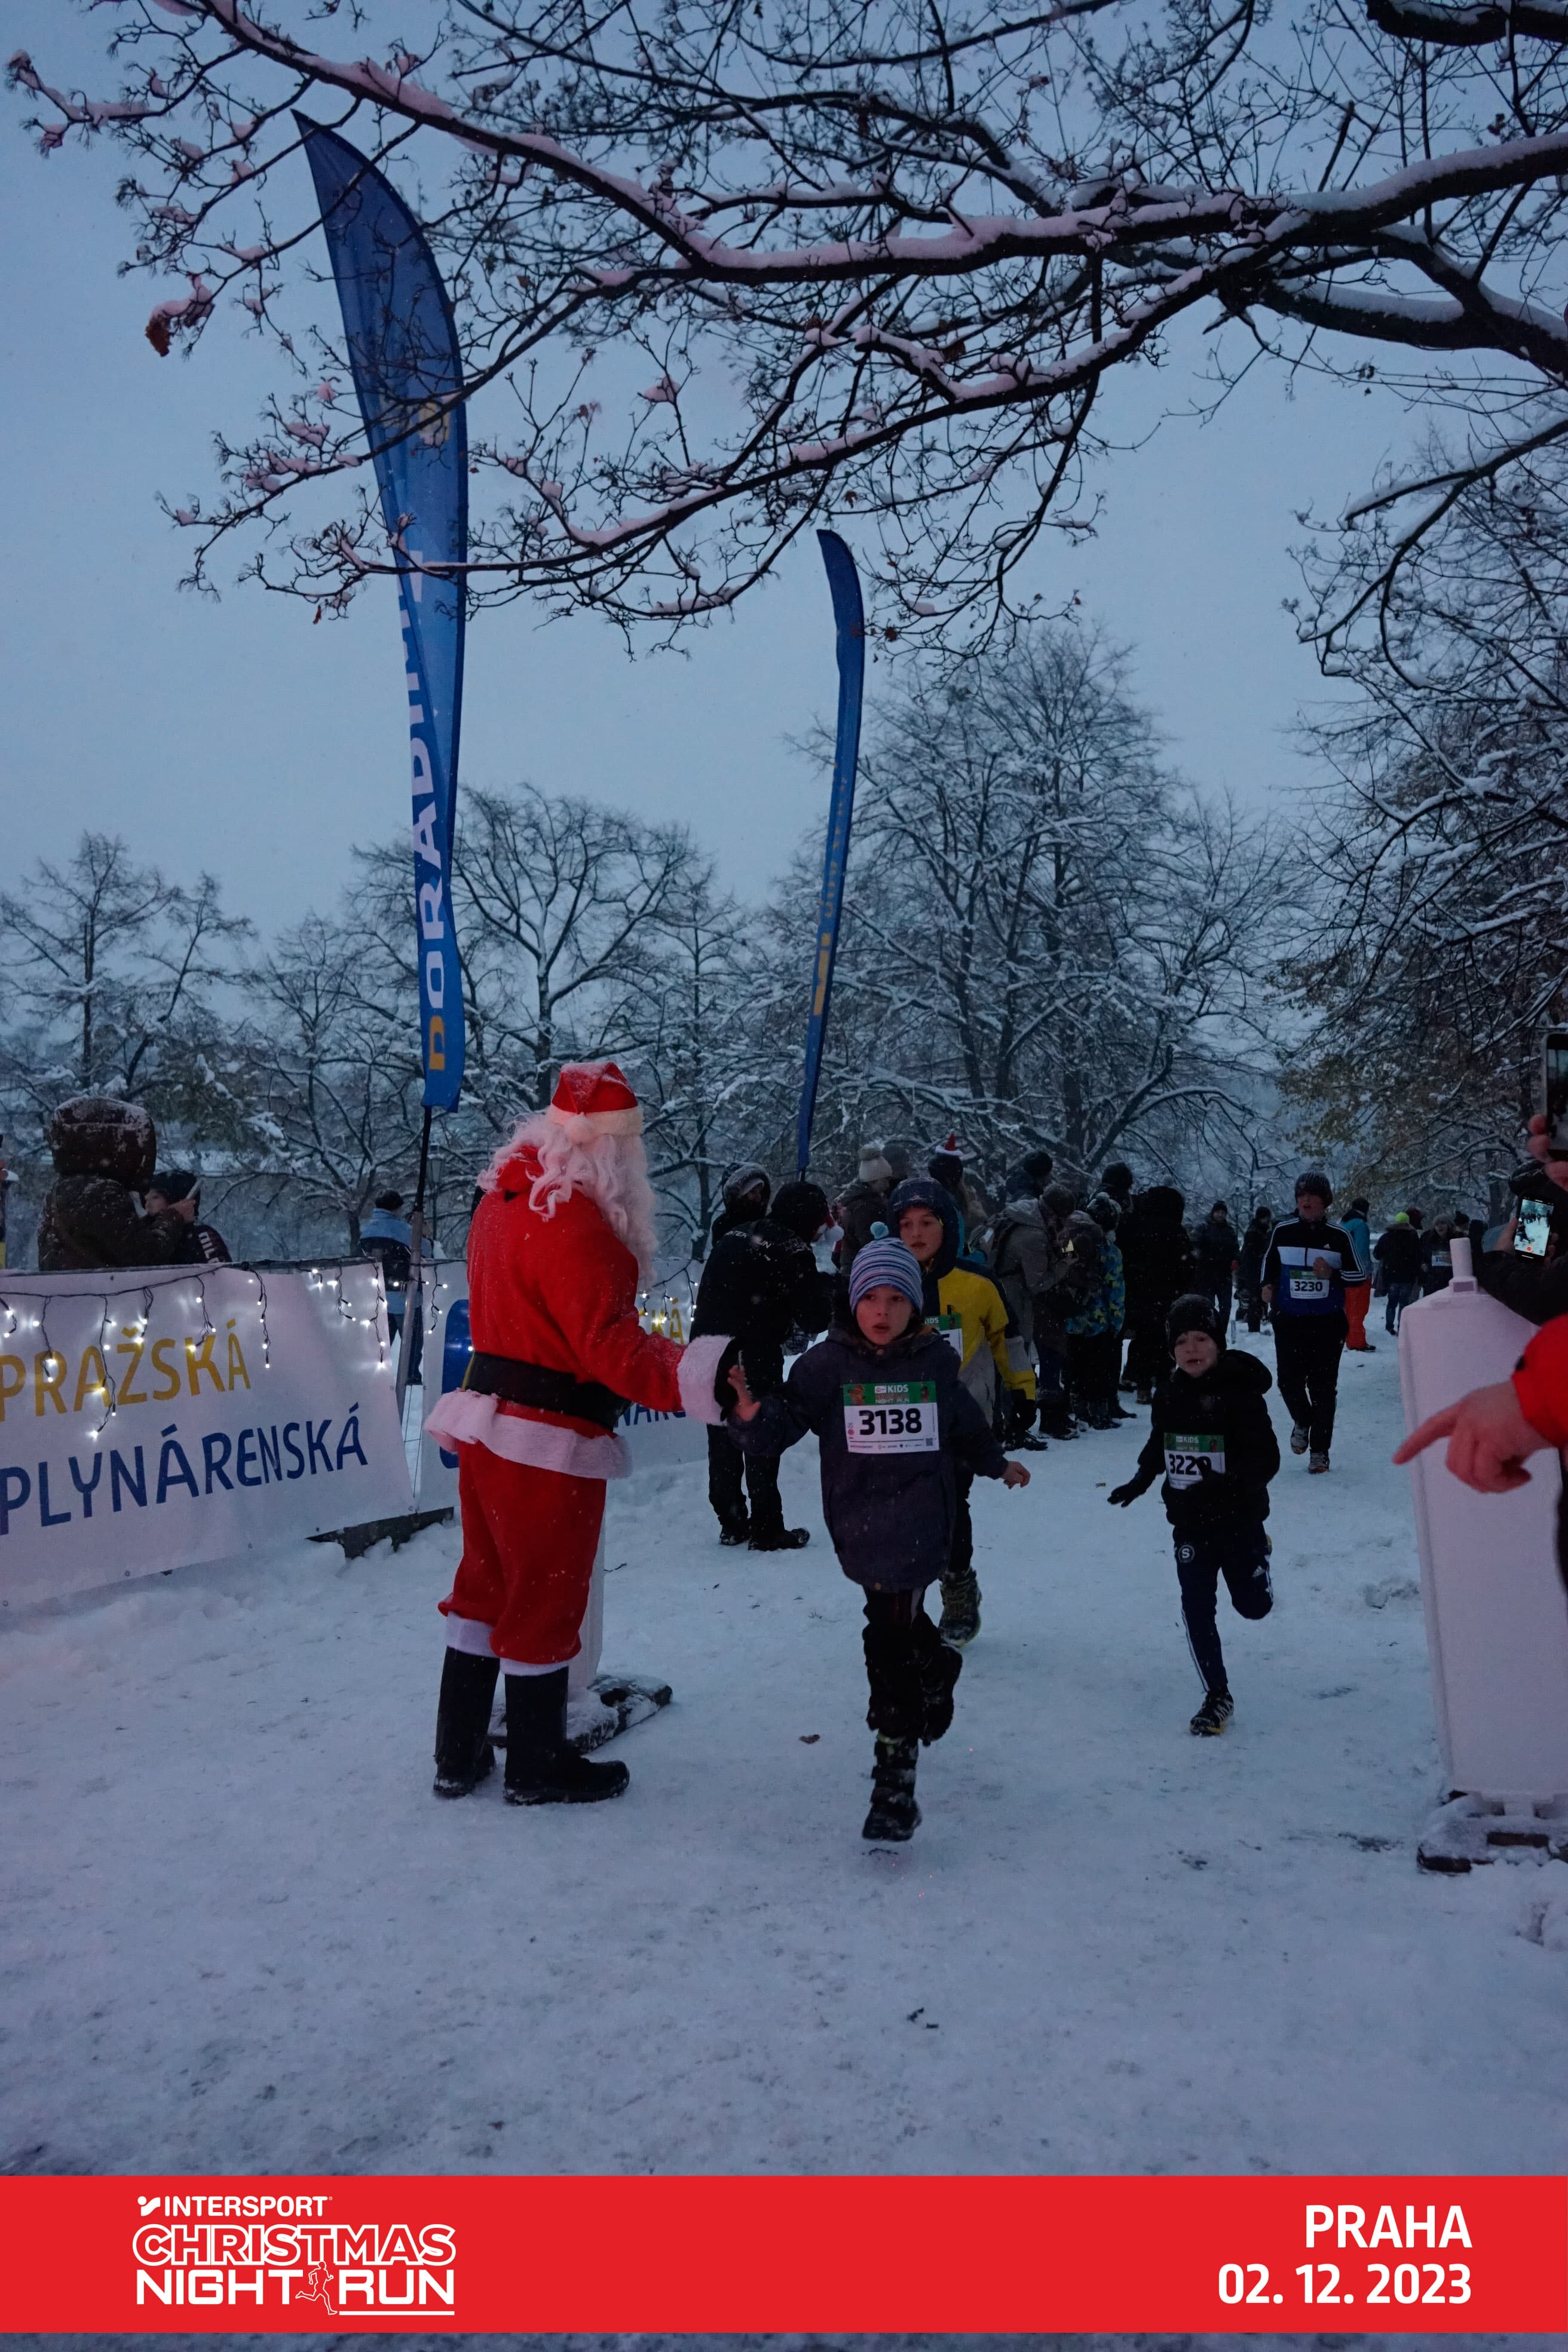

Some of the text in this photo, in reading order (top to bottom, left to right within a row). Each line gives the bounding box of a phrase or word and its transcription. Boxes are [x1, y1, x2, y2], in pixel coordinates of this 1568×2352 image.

[1294, 1281, 1323, 1291] 3230
[0, 1318, 251, 1422] PRAŽSKÁ
[887, 1385, 909, 1393] KIDS
[859, 1408, 922, 1435] 3138
[0, 1401, 368, 1536] PLYNÁRENSKÁ
